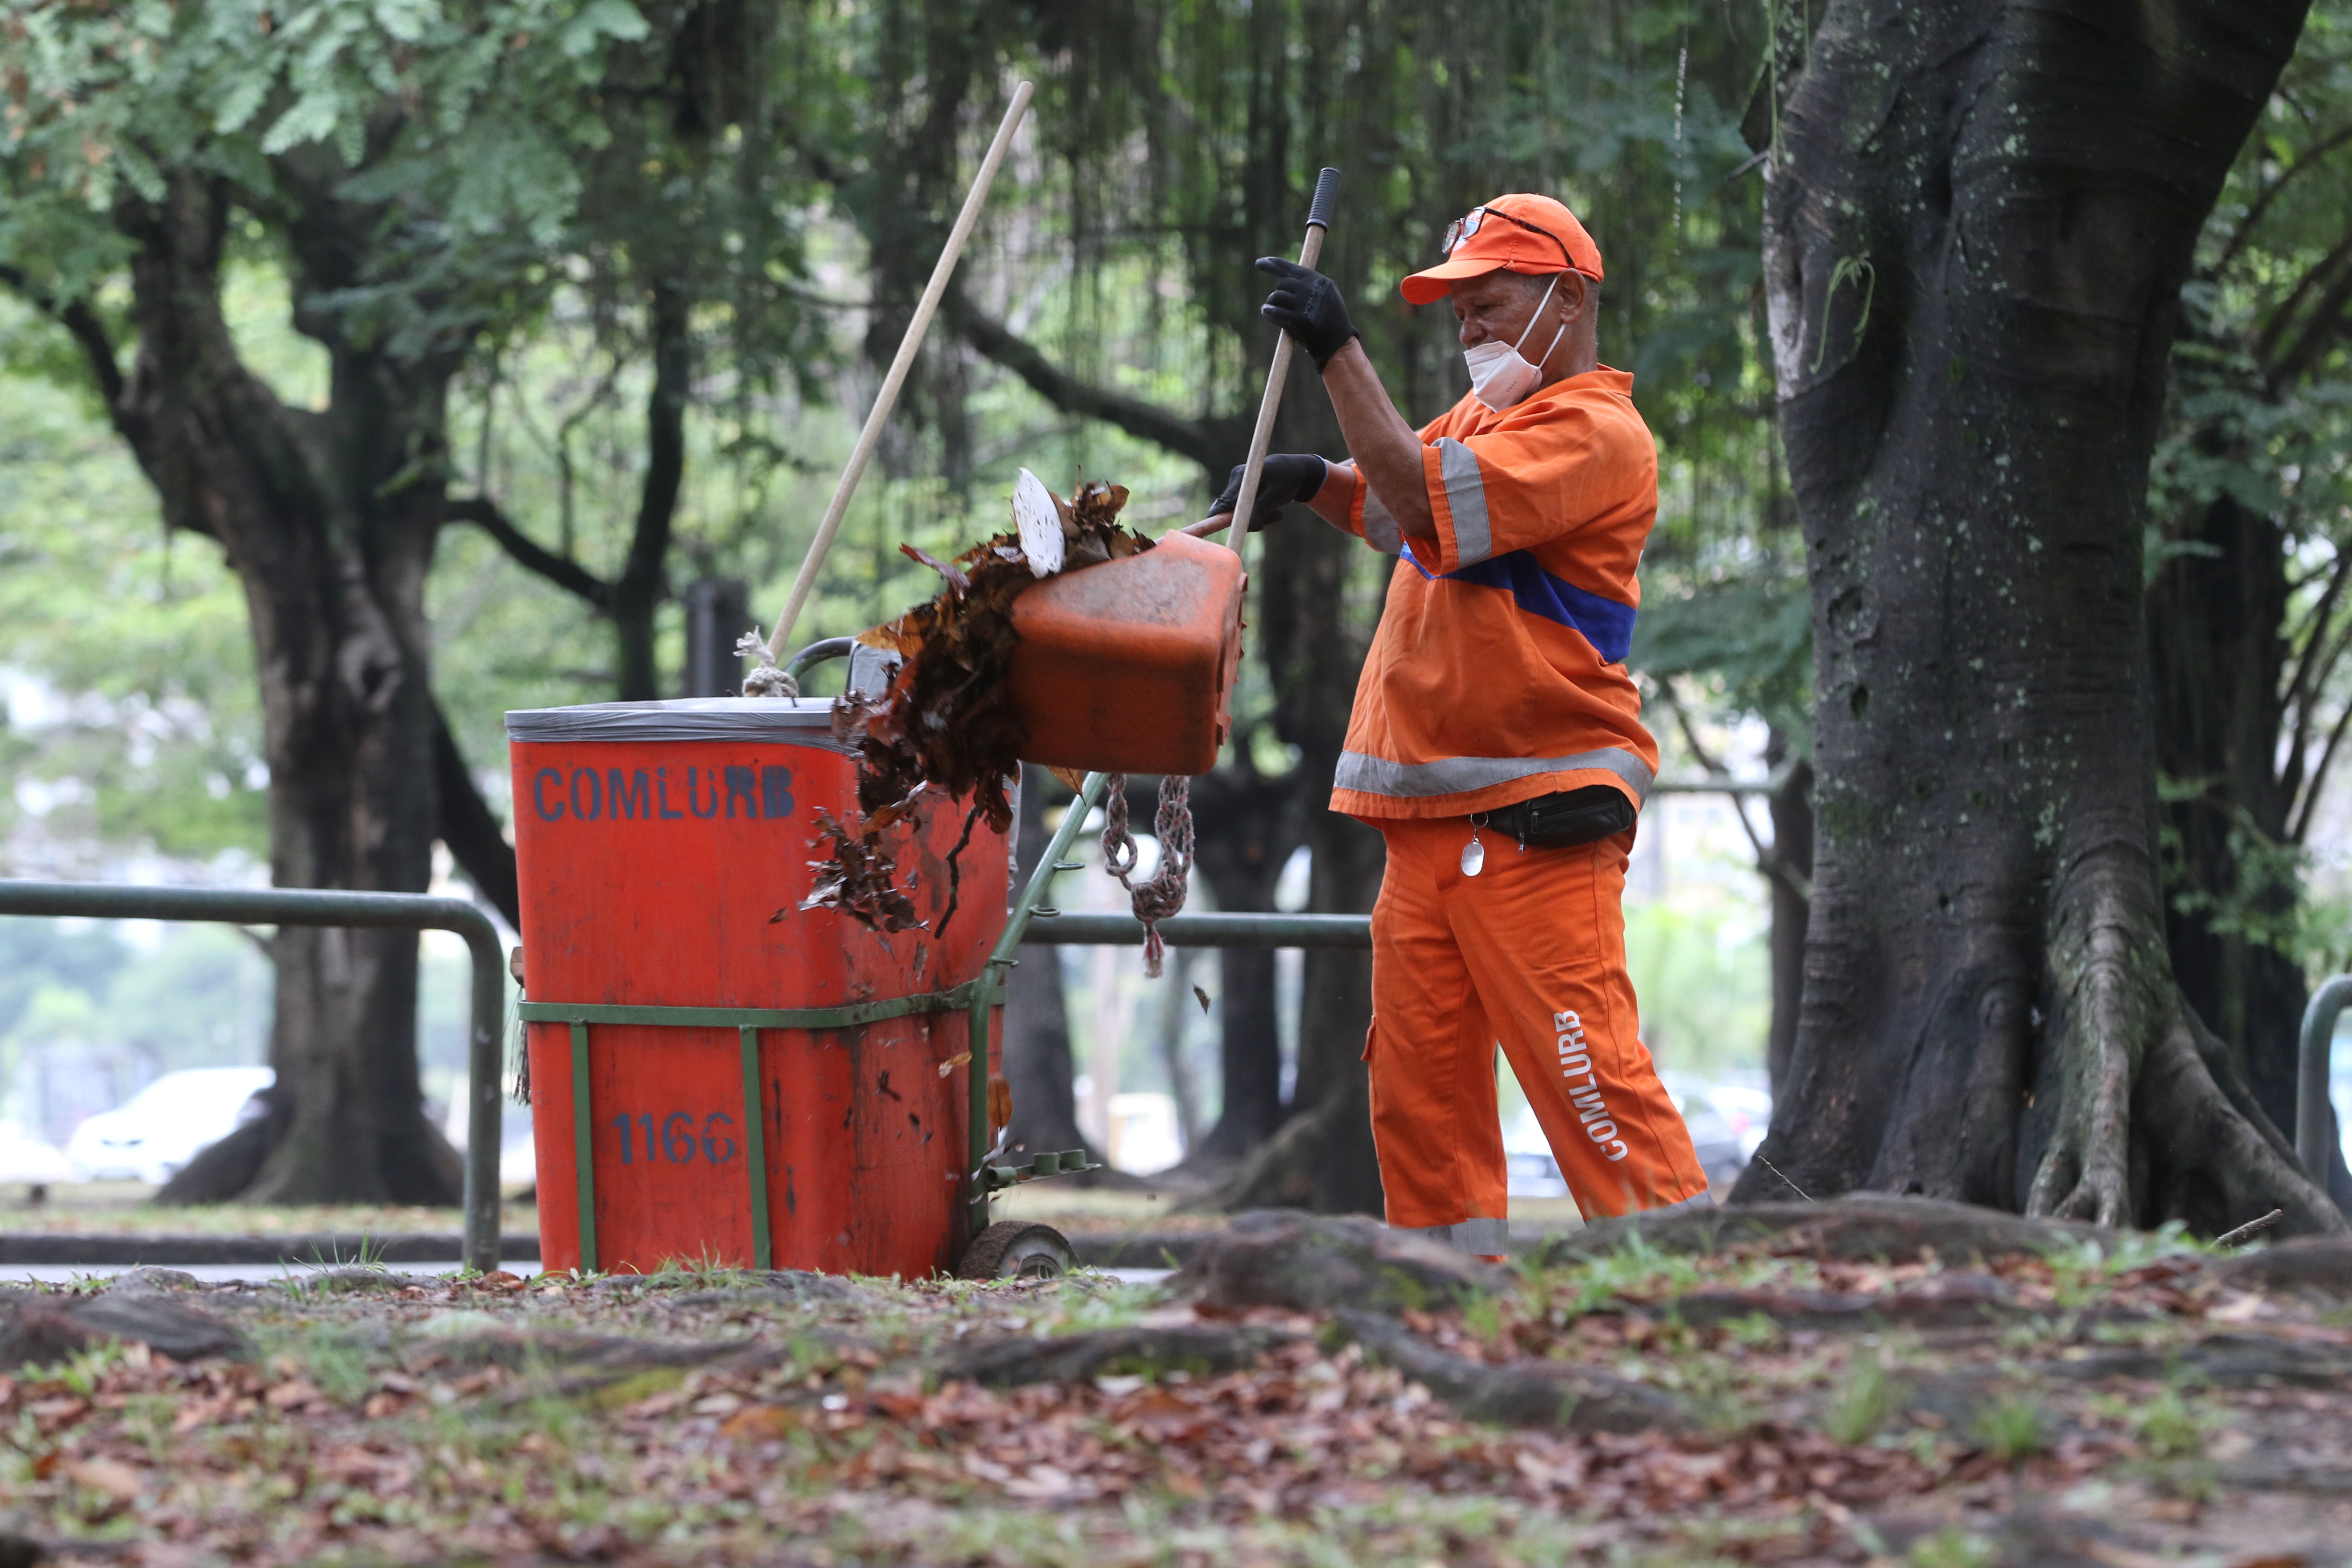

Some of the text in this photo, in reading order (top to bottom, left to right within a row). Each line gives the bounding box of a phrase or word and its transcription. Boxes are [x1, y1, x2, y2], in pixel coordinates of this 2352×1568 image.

[533, 765, 795, 822] COMLURB
[1553, 1010, 1628, 1161] COMLURB
[612, 1111, 736, 1165] 1166
